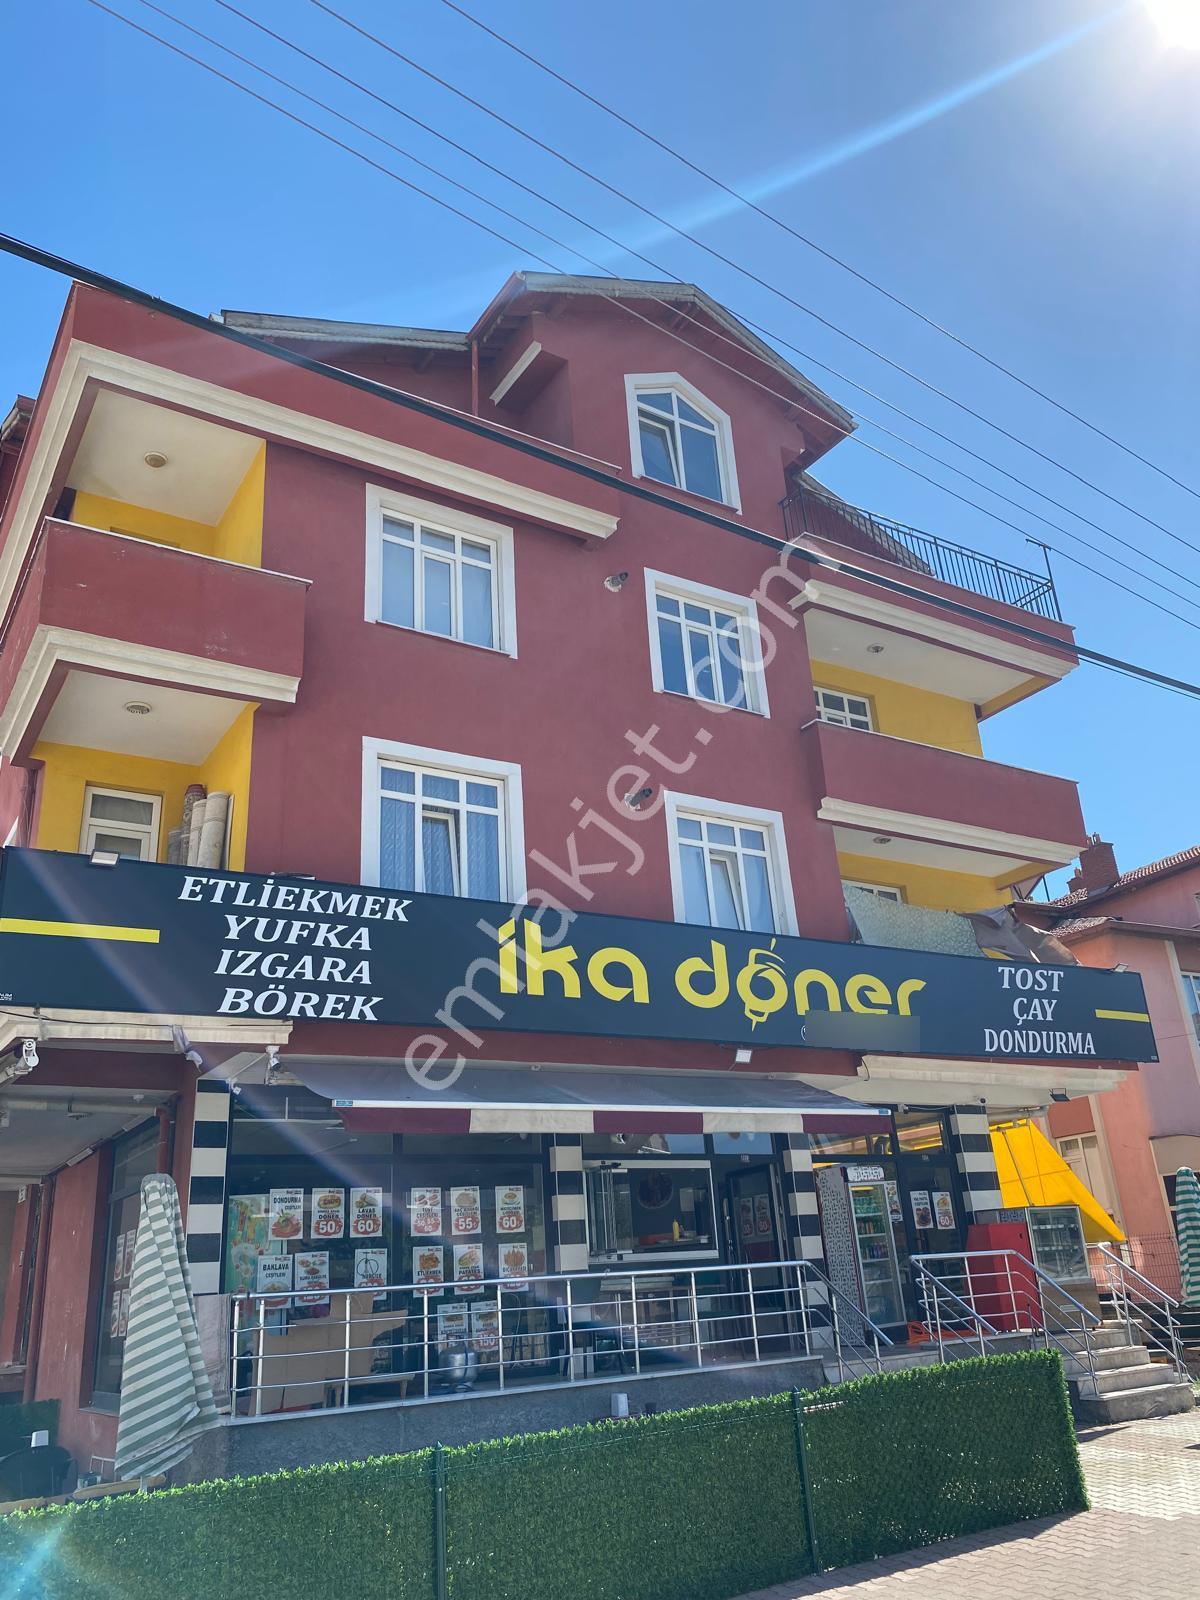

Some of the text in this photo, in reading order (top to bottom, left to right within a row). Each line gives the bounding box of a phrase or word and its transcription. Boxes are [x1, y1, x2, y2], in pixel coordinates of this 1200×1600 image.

[177, 875, 413, 922] ETLİEKMEK
[223, 914, 372, 951] YUFKA
[213, 949, 372, 985] IZGARA
[997, 966, 1065, 992] TOST
[216, 983, 384, 1021] BÖREK
[1012, 996, 1058, 1026] ÇAY
[983, 1027, 1097, 1055] DONDURMA
